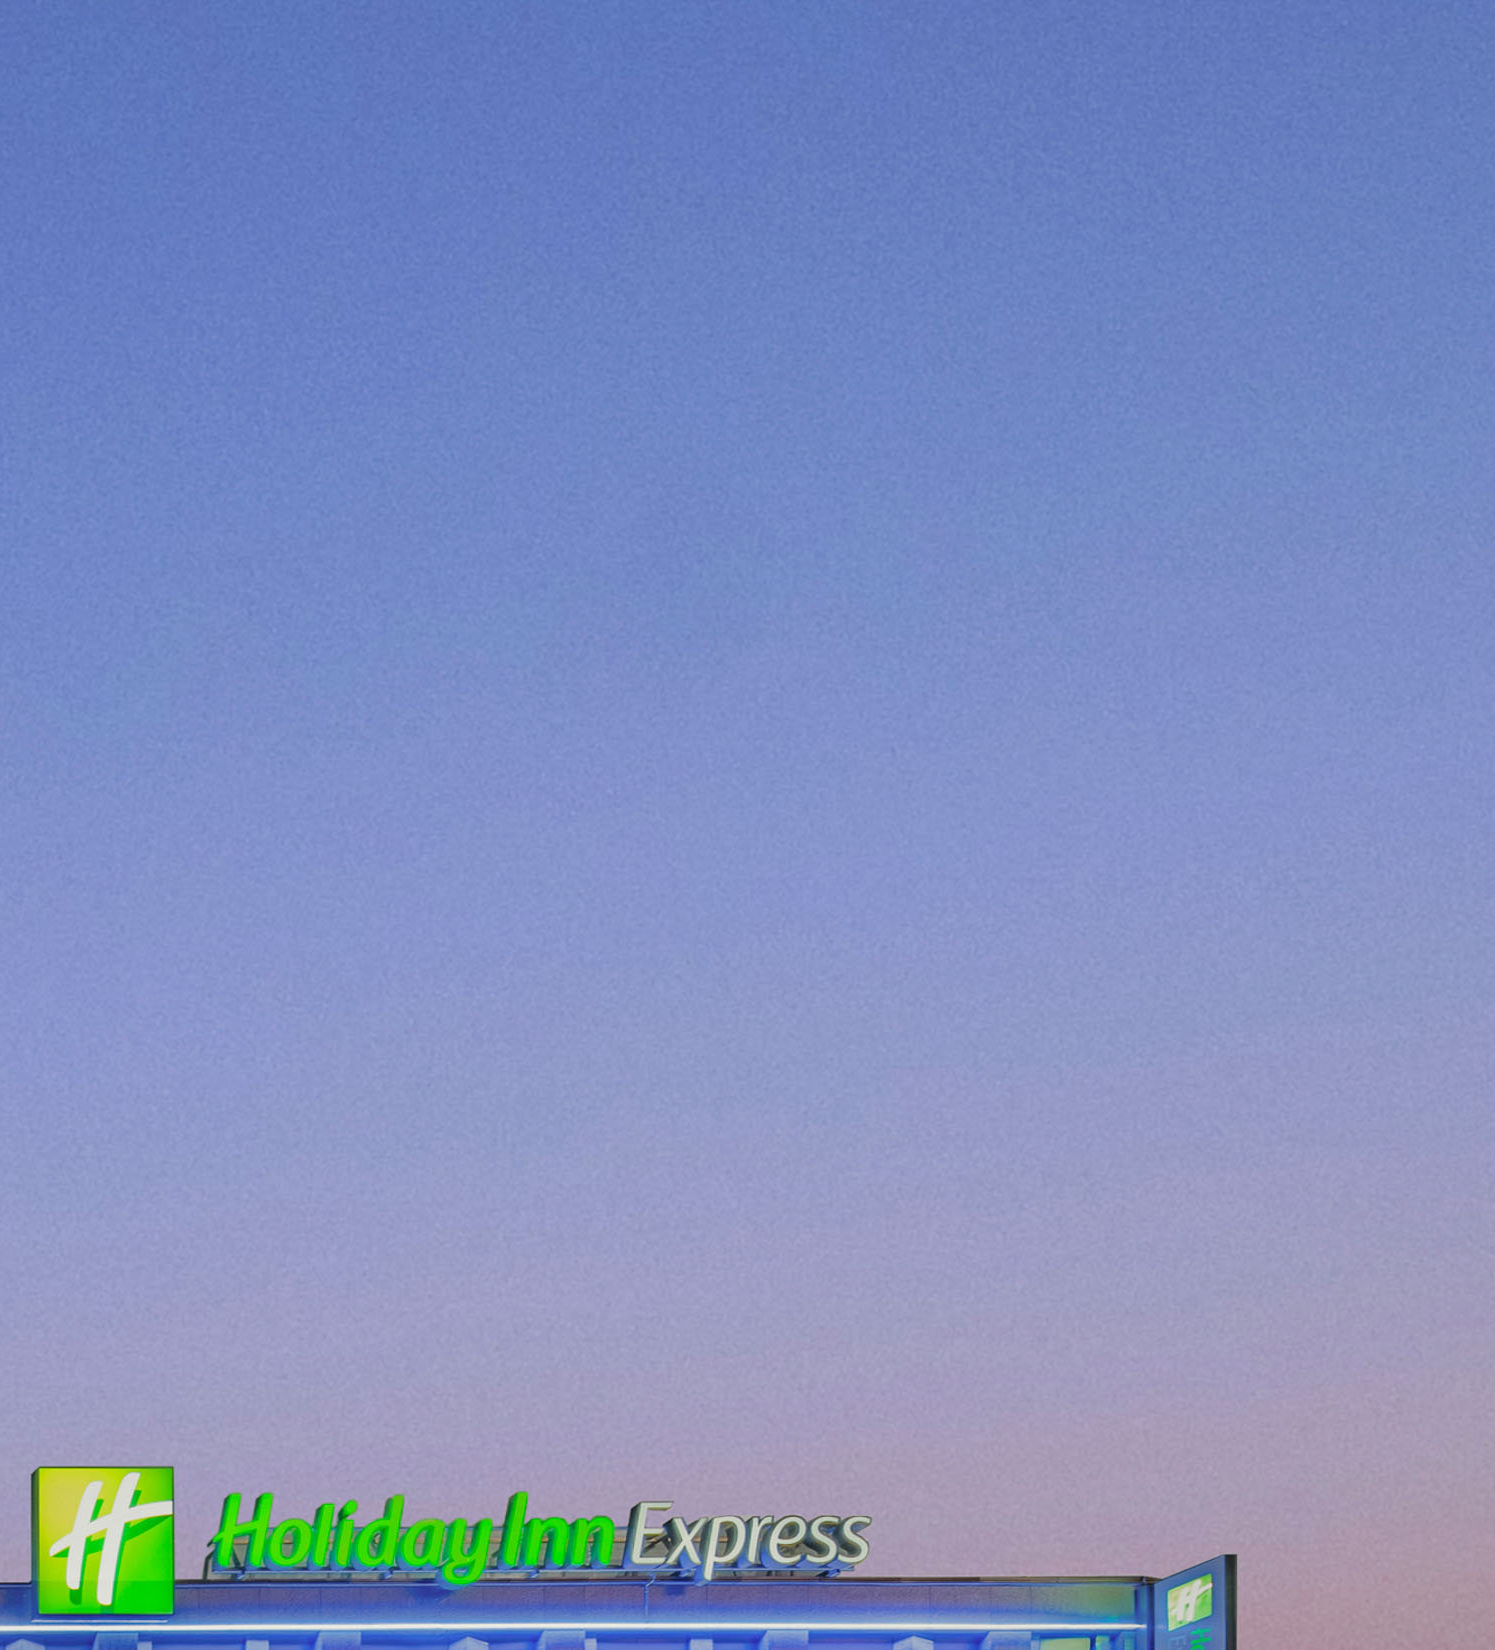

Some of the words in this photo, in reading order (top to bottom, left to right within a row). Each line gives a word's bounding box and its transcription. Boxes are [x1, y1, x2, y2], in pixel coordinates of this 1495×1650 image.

[211, 1492, 491, 1584] Holiday
[502, 1490, 612, 1568] Inn
[629, 1500, 871, 1584] Express
